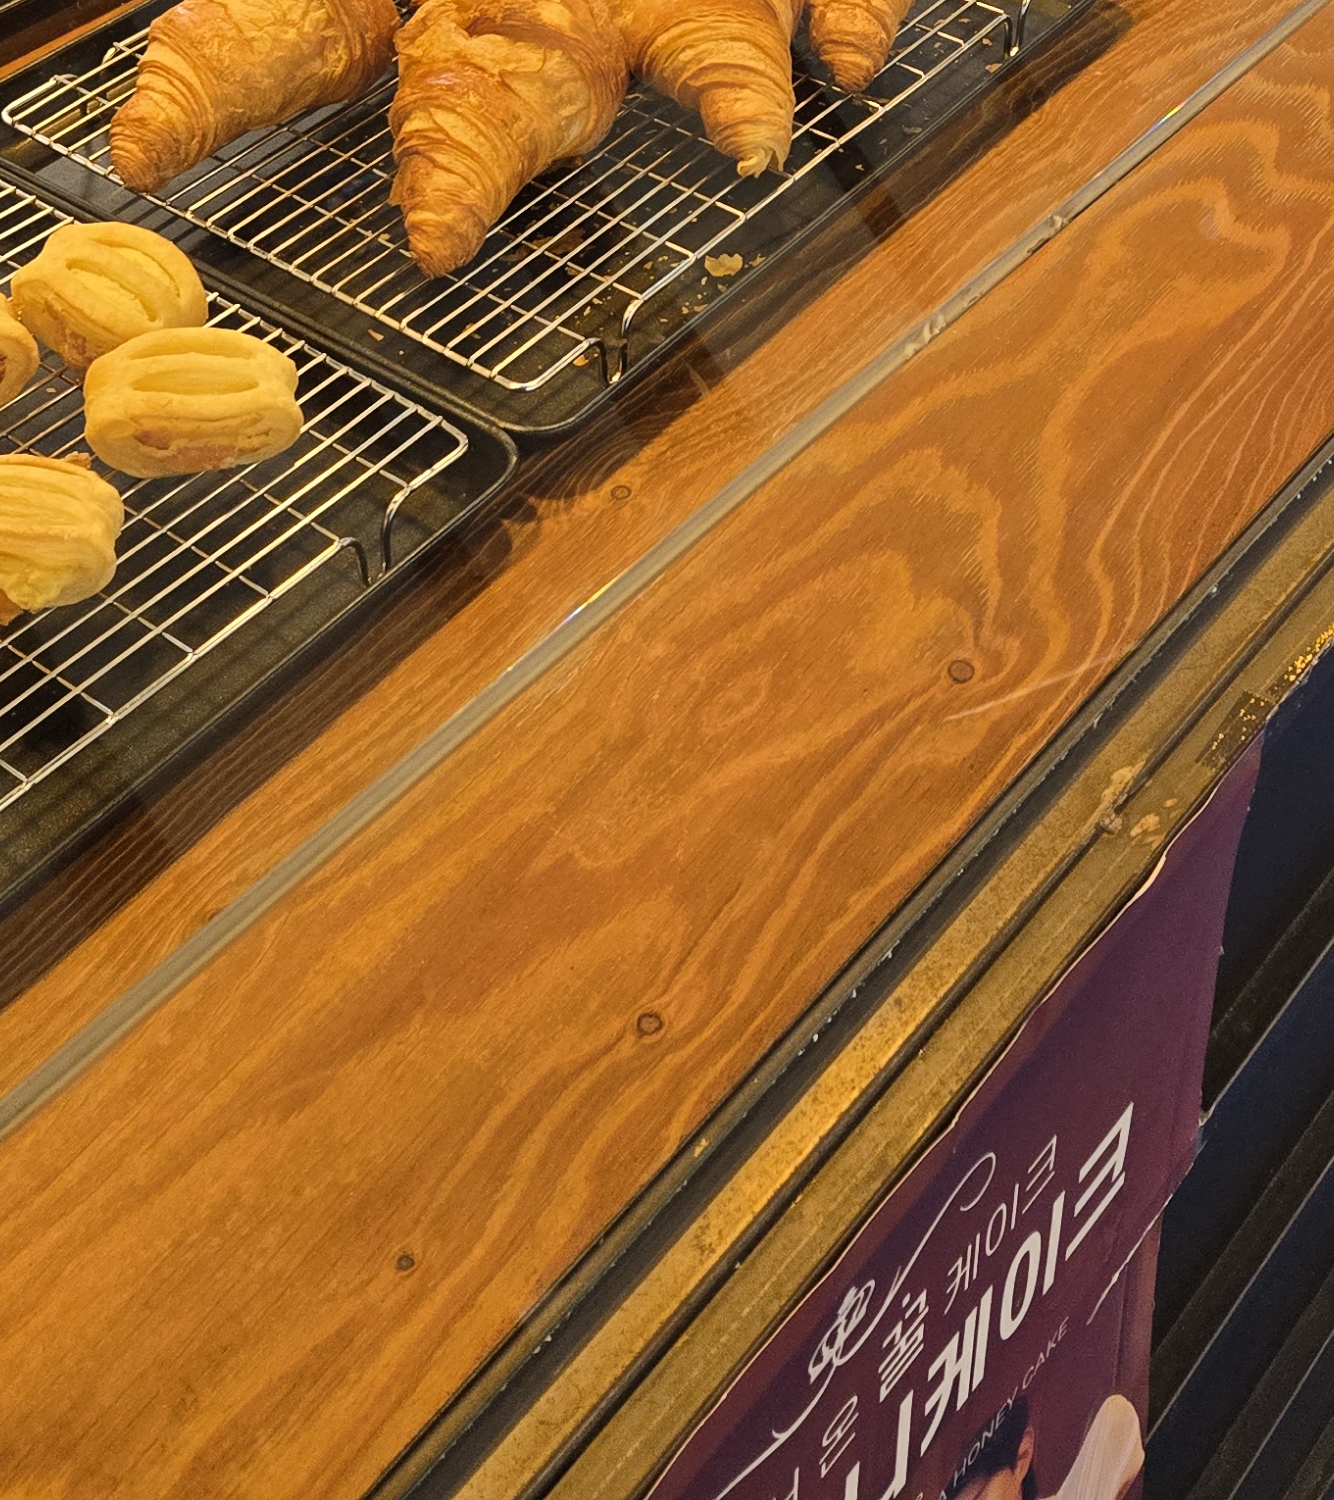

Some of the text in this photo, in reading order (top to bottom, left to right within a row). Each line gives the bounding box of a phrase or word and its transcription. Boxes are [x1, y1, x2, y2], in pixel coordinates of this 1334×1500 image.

[943, 1134, 1058, 1316] 케이크
[952, 1315, 1069, 1488] HONEY CAKE
